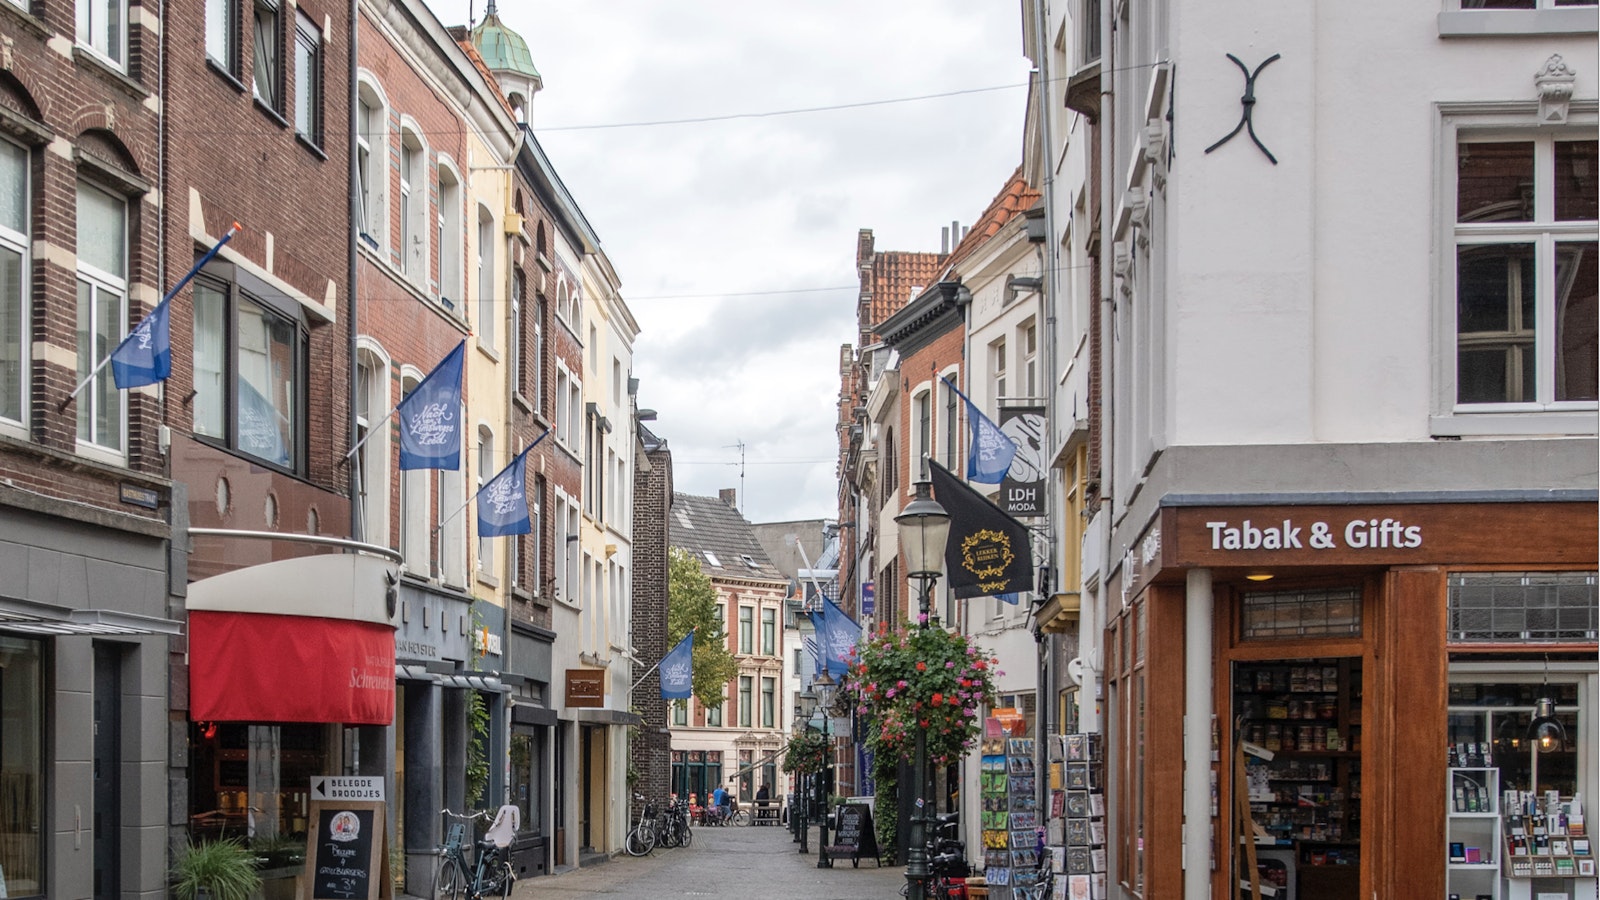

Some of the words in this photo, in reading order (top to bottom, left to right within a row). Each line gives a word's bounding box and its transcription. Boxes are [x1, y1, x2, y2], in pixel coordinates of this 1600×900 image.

[1008, 488, 1036, 501] LDH
[1008, 503, 1036, 511] MODA
[1206, 519, 1303, 550] Tabak
[1309, 521, 1336, 549] &
[1344, 518, 1422, 548] Gifts
[332, 790, 380, 798] BROODJES
